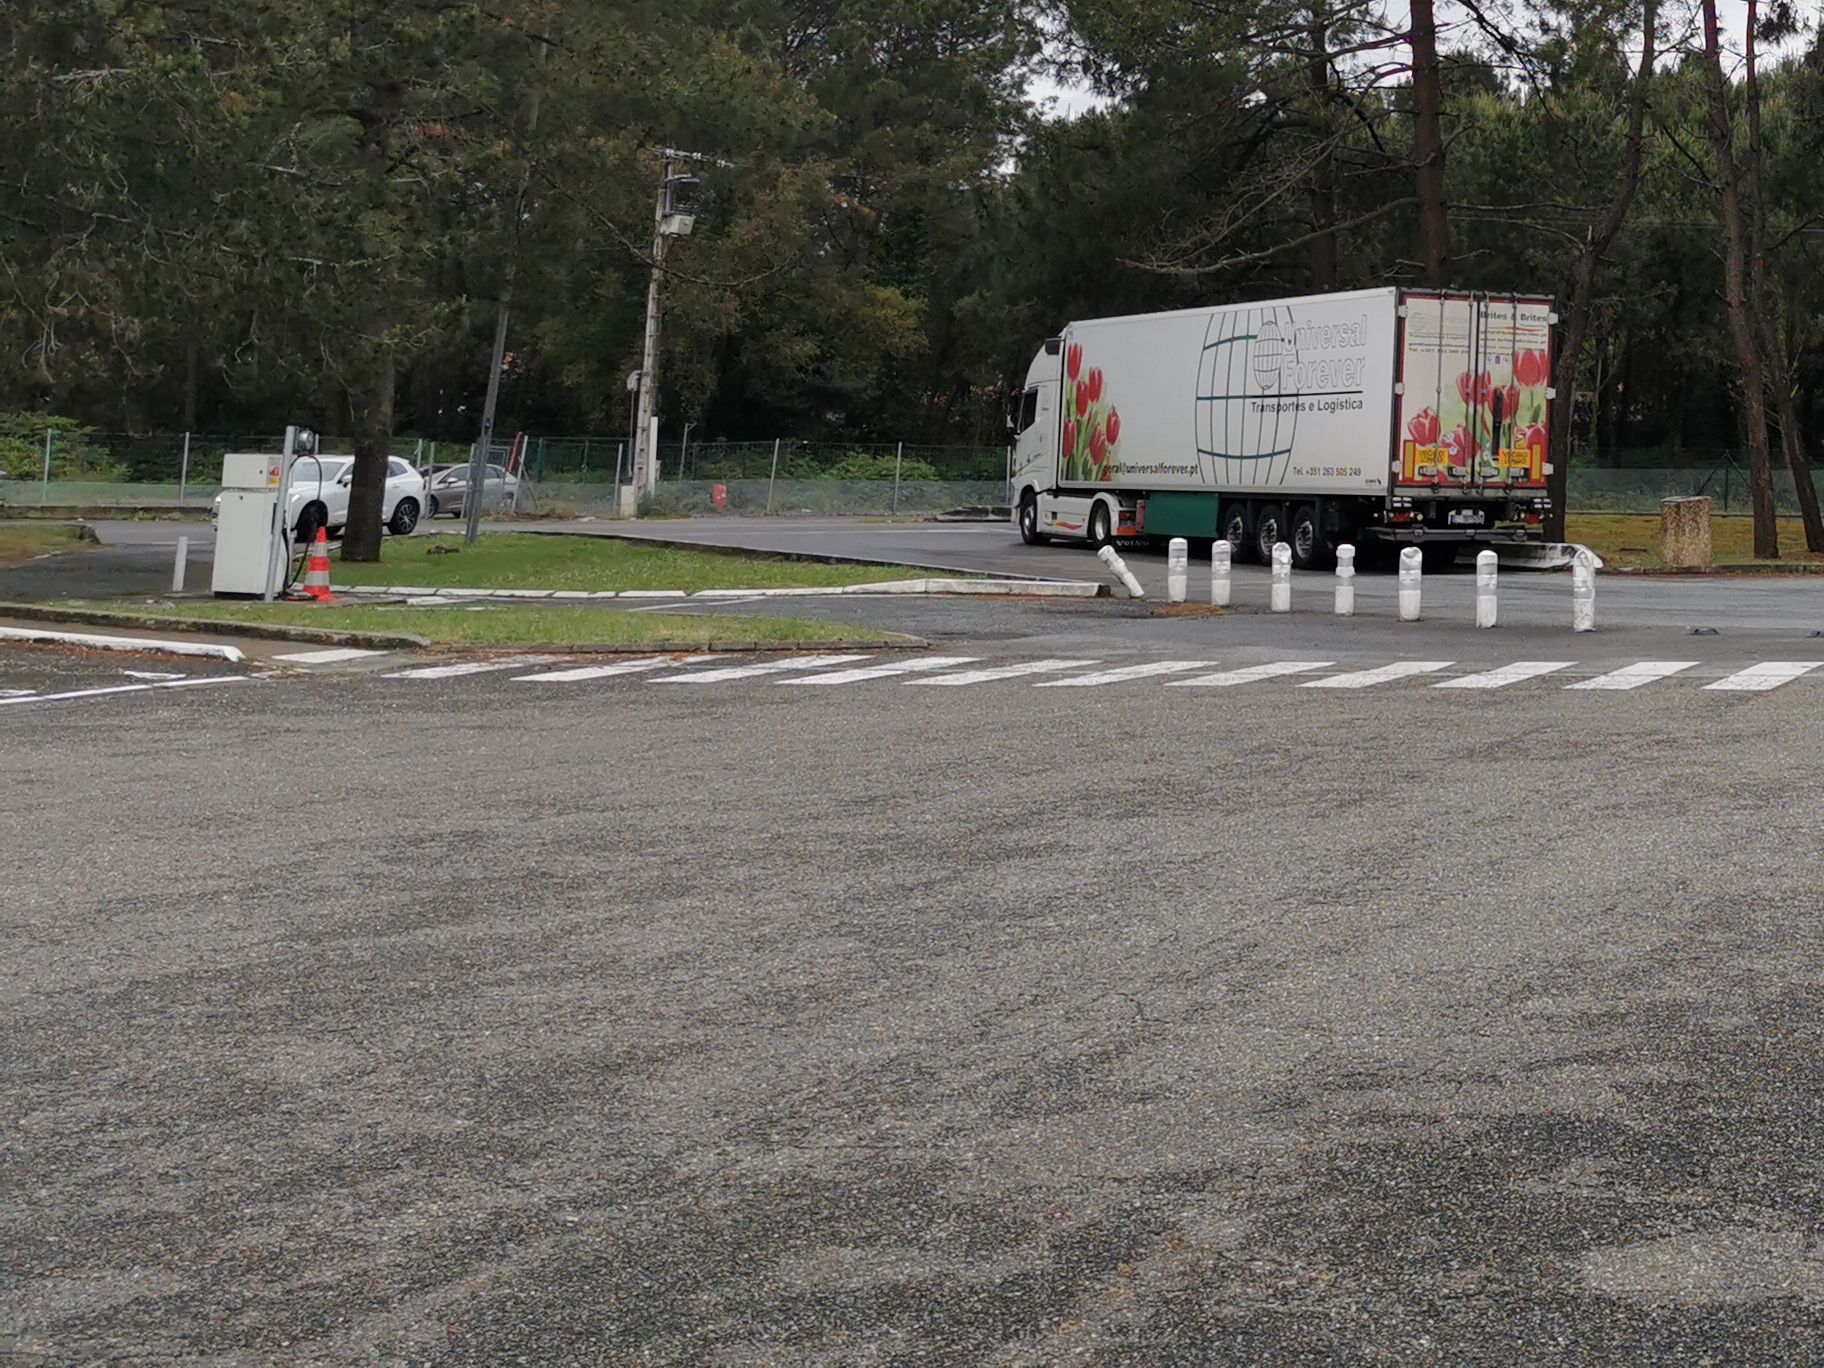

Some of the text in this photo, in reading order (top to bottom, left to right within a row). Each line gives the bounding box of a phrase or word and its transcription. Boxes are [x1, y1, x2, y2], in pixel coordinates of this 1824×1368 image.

[1520, 313, 1547, 323] Brites
[1284, 314, 1368, 352] Universal
[1282, 353, 1366, 390] Forever
[1251, 401, 1306, 413] Transportes
[1308, 402, 1315, 412] e
